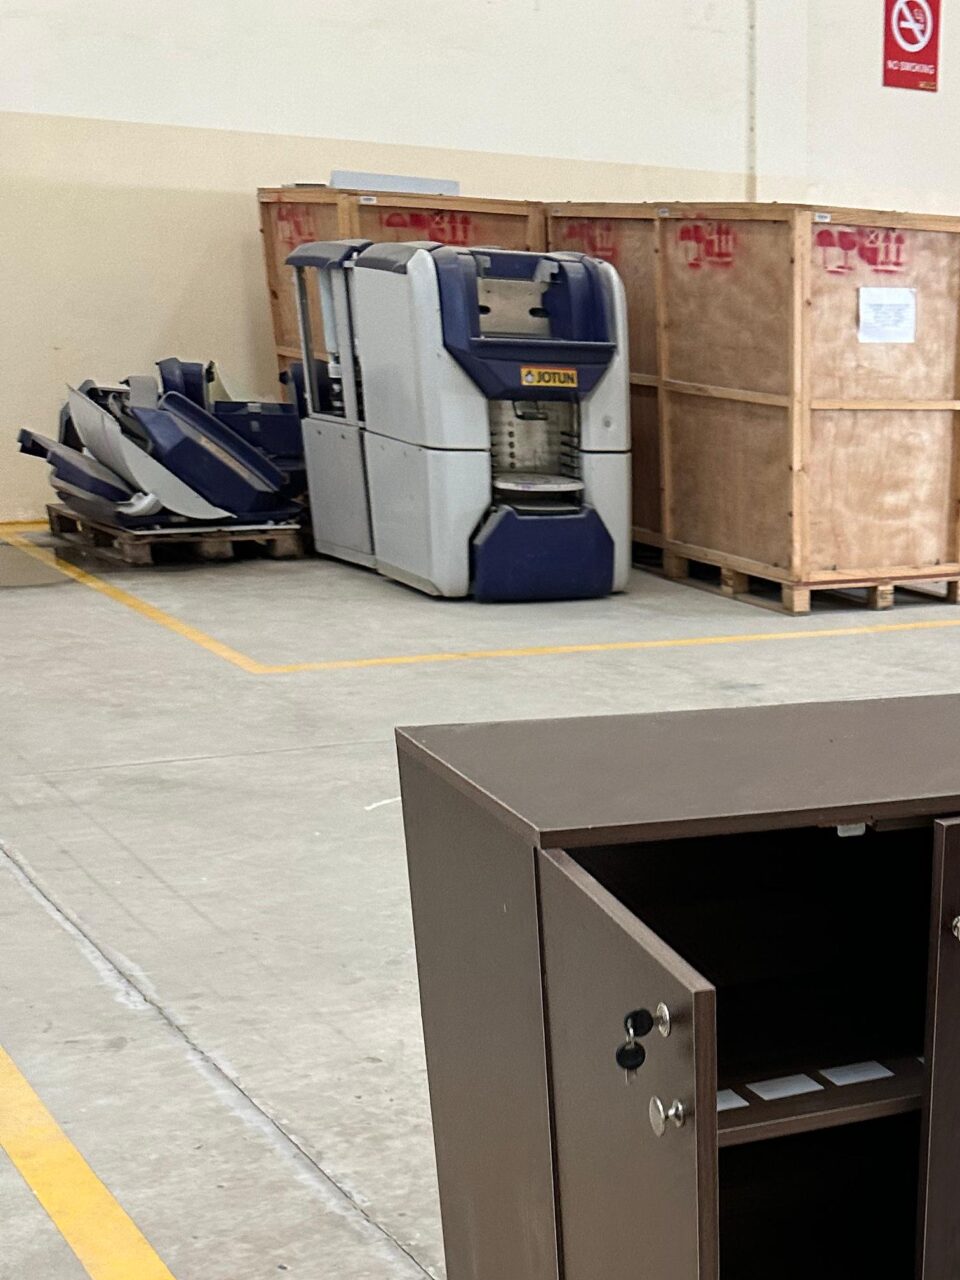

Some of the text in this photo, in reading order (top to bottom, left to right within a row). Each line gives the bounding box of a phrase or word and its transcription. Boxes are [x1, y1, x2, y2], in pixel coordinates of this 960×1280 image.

[887, 60, 935, 75] NO SMOKING
[537, 371, 575, 384] JOTUN
